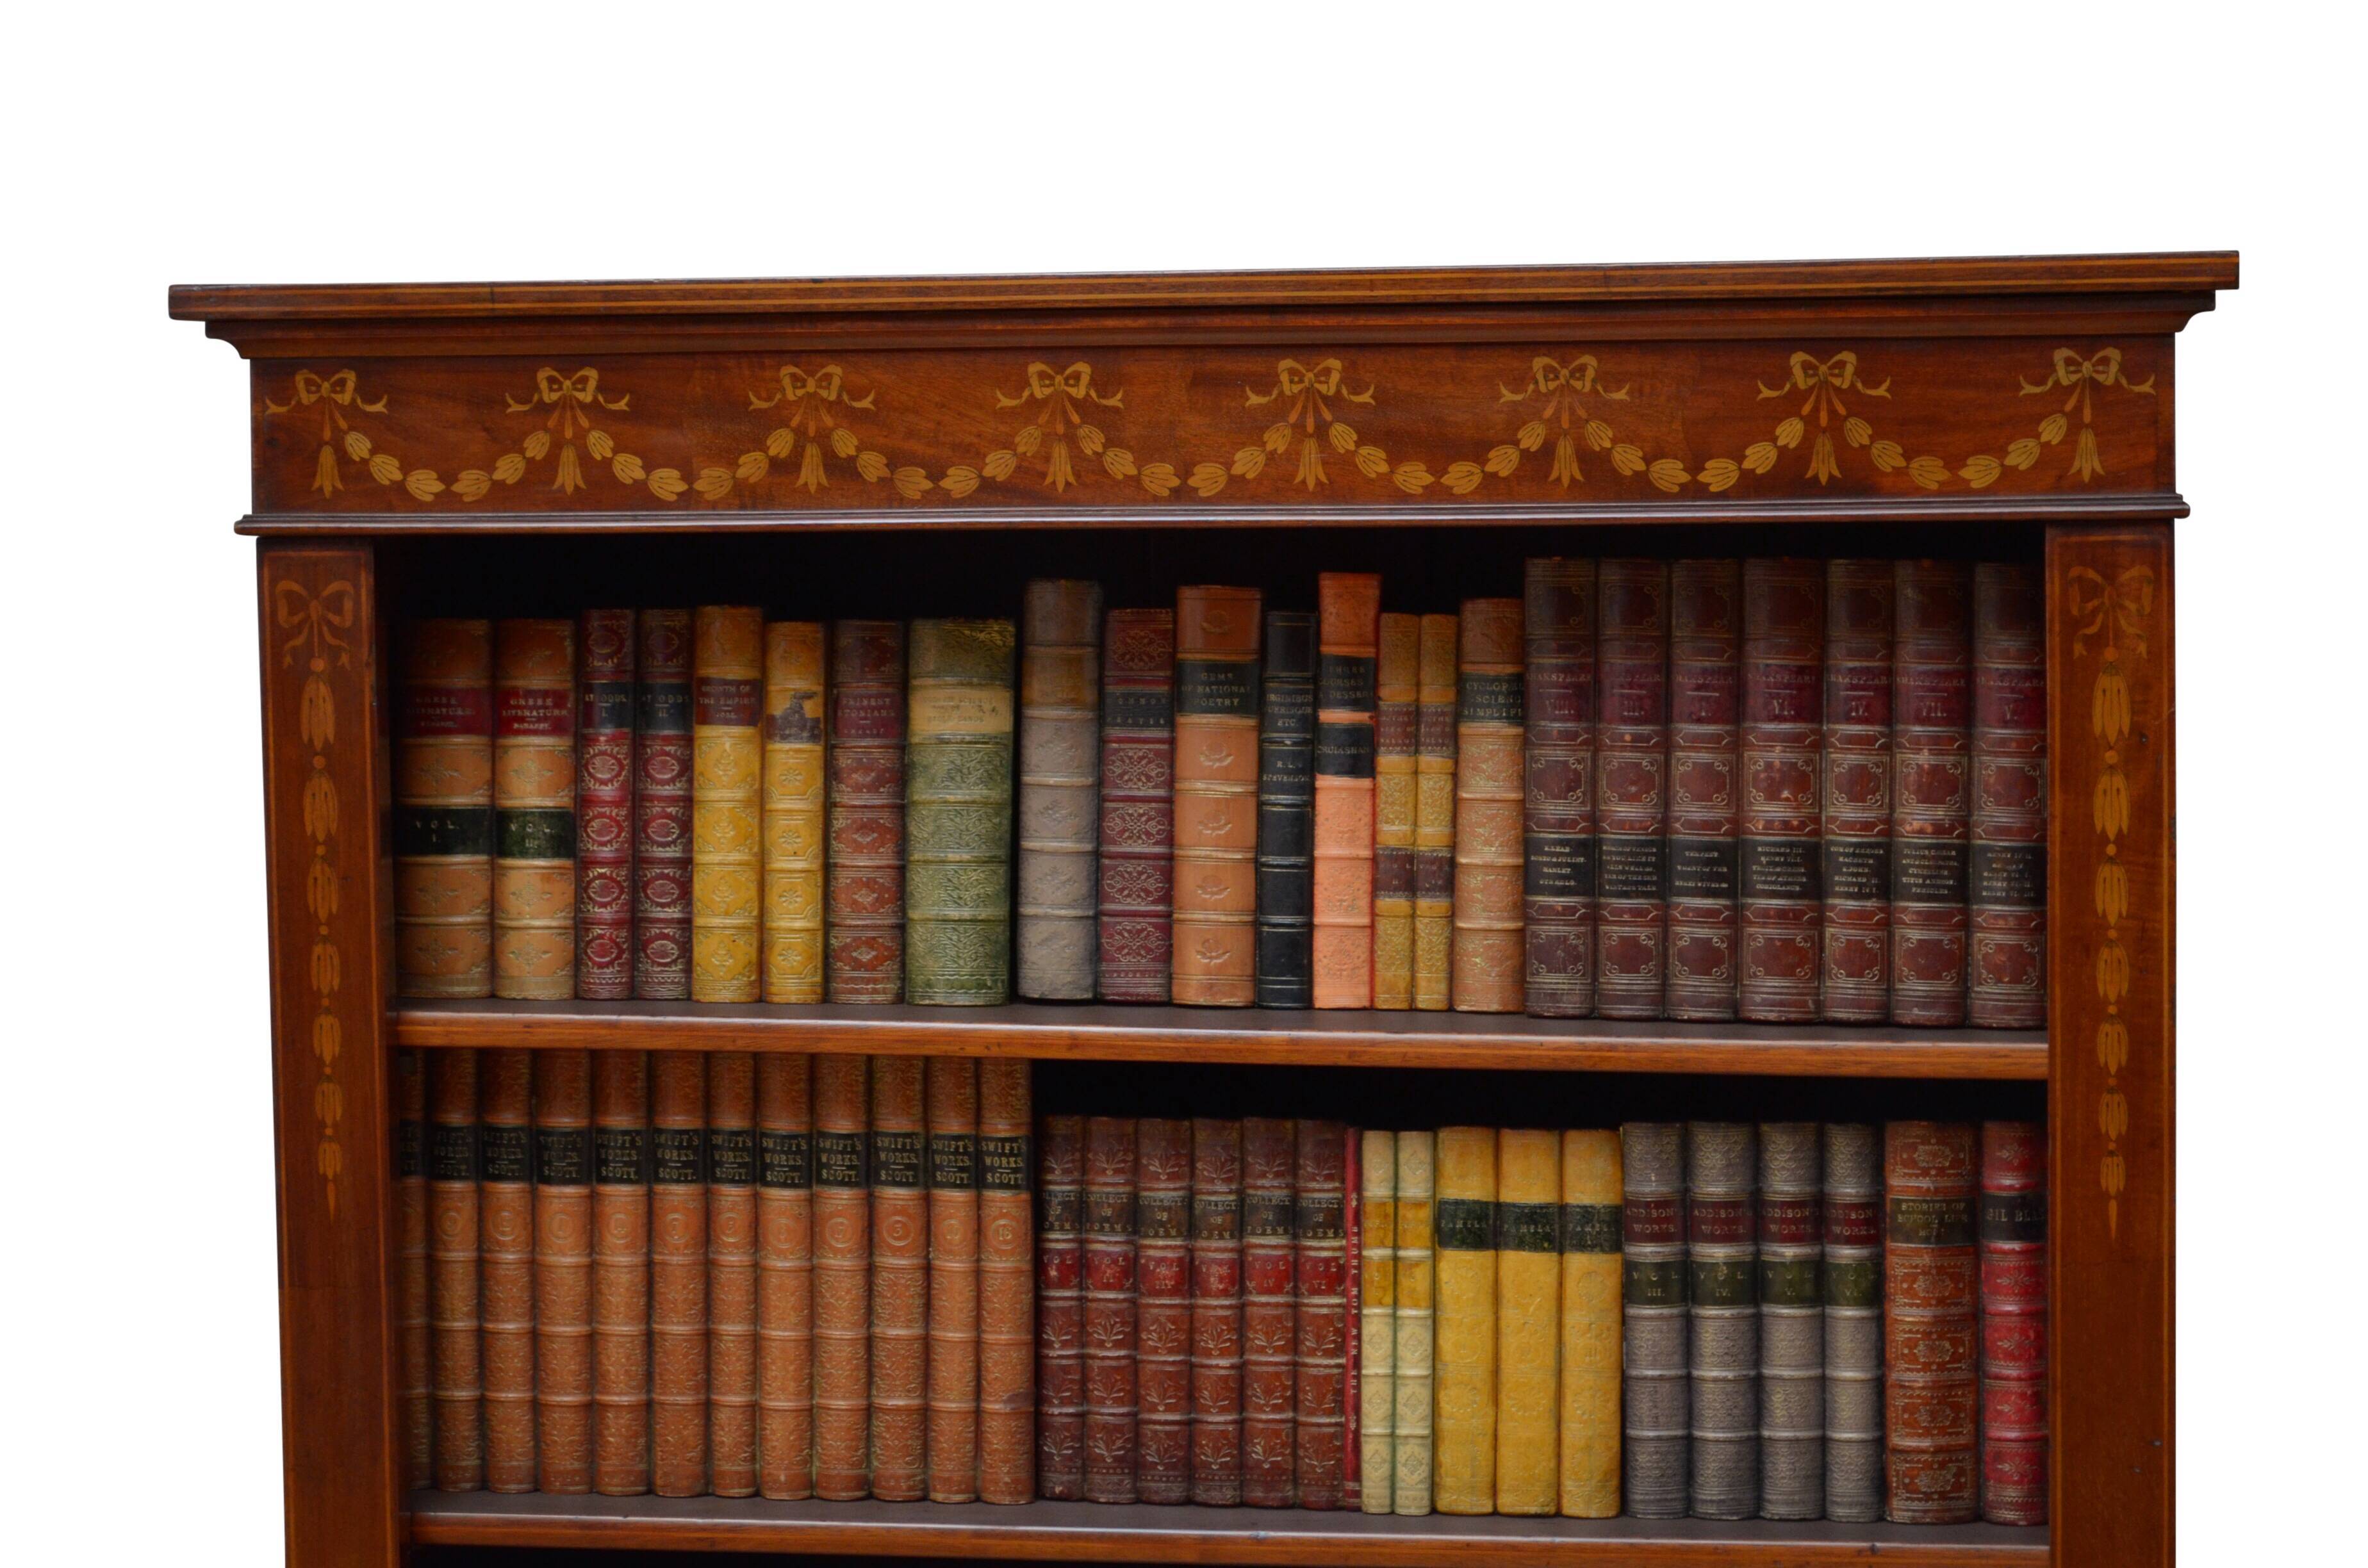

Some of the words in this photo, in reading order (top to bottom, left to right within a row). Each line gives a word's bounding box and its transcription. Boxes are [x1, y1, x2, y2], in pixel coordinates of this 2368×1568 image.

[654, 1132, 700, 1147] SWIFT'S
[711, 1134, 752, 1148] SWIFT'S
[762, 1136, 807, 1151] SWIFT'S
[819, 1136, 862, 1152] SWIFT'S
[876, 1135, 921, 1150] SWIFT'S
[932, 1139, 974, 1152] SWIFT'S
[980, 1138, 1026, 1154] SWIFT'S
[656, 1147, 698, 1161] WORKS.
[712, 1149, 752, 1163] WORKS.
[764, 1152, 805, 1166] WORKS.
[819, 1152, 861, 1166] WORKS.
[878, 1150, 919, 1164] WORKS.
[933, 1154, 973, 1166] WORKS.
[658, 1166, 697, 1180] SCOTT.
[715, 1166, 750, 1180] SCOTT.
[765, 1170, 804, 1184] SCOTT.
[821, 1168, 860, 1182] SCOTT.
[879, 1168, 917, 1182] SCOTT.
[935, 1170, 972, 1184] SCOTT.
[1101, 1208, 1113, 1217] OF
[1952, 1203, 1966, 1211] OF
[1156, 1211, 1169, 1221] OF
[1210, 1216, 1224, 1225] OF
[1261, 1211, 1273, 1220] OF
[1313, 1213, 1324, 1222] OF
[1897, 1214, 1939, 1223] SCHOOL
[1986, 1208, 2009, 1222] GIL
[1350, 1226, 1358, 1275] THUMB
[1254, 1261, 1287, 1271] VOL
[1350, 1287, 1358, 1315] TOM
[1350, 1328, 1358, 1356] NEW
